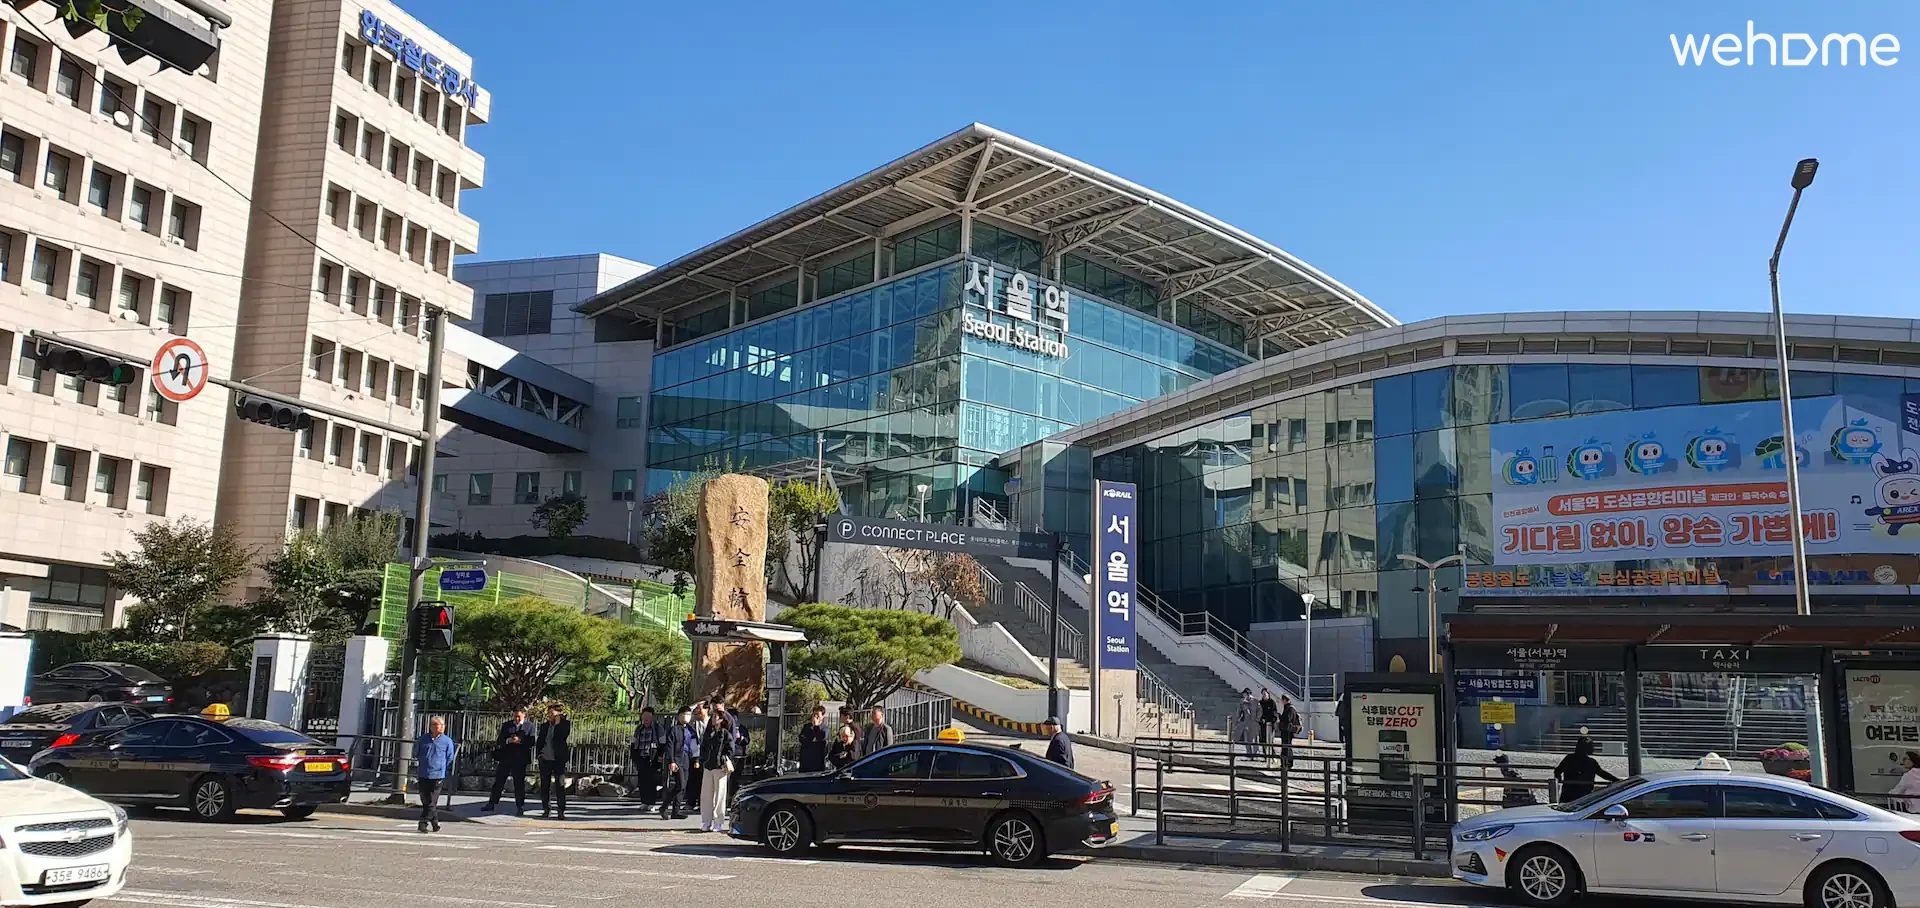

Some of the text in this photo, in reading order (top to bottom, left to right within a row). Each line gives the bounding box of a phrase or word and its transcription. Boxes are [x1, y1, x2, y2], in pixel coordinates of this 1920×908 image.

[361, 9, 479, 108] 한국철도공사
[964, 261, 1069, 333] 서울역
[963, 312, 1069, 359] Seoul Station
[1103, 488, 1132, 499] KORAIL
[1557, 496, 1600, 512] 서울역
[1603, 489, 1708, 509] 도심공항터미널
[1896, 506, 1919, 514] AREX
[861, 524, 922, 541] CONNECT
[925, 530, 966, 546] PLACE
[1504, 511, 1837, 552] 기다림 없이, 양손 가볍게!
[727, 506, 751, 647] 安全輸
[1107, 514, 1129, 622] 서울역
[1465, 568, 1721, 588] 공항철도 서울역 도심공항터미널
[1106, 635, 1125, 645] Seoul
[1106, 644, 1130, 654] Station
[1505, 647, 1568, 658] 서울(서부)역
[1699, 649, 1750, 660] TAXI
[1469, 678, 1534, 689] 서울지방철도경찰대
[77, 867, 103, 880] 9486
